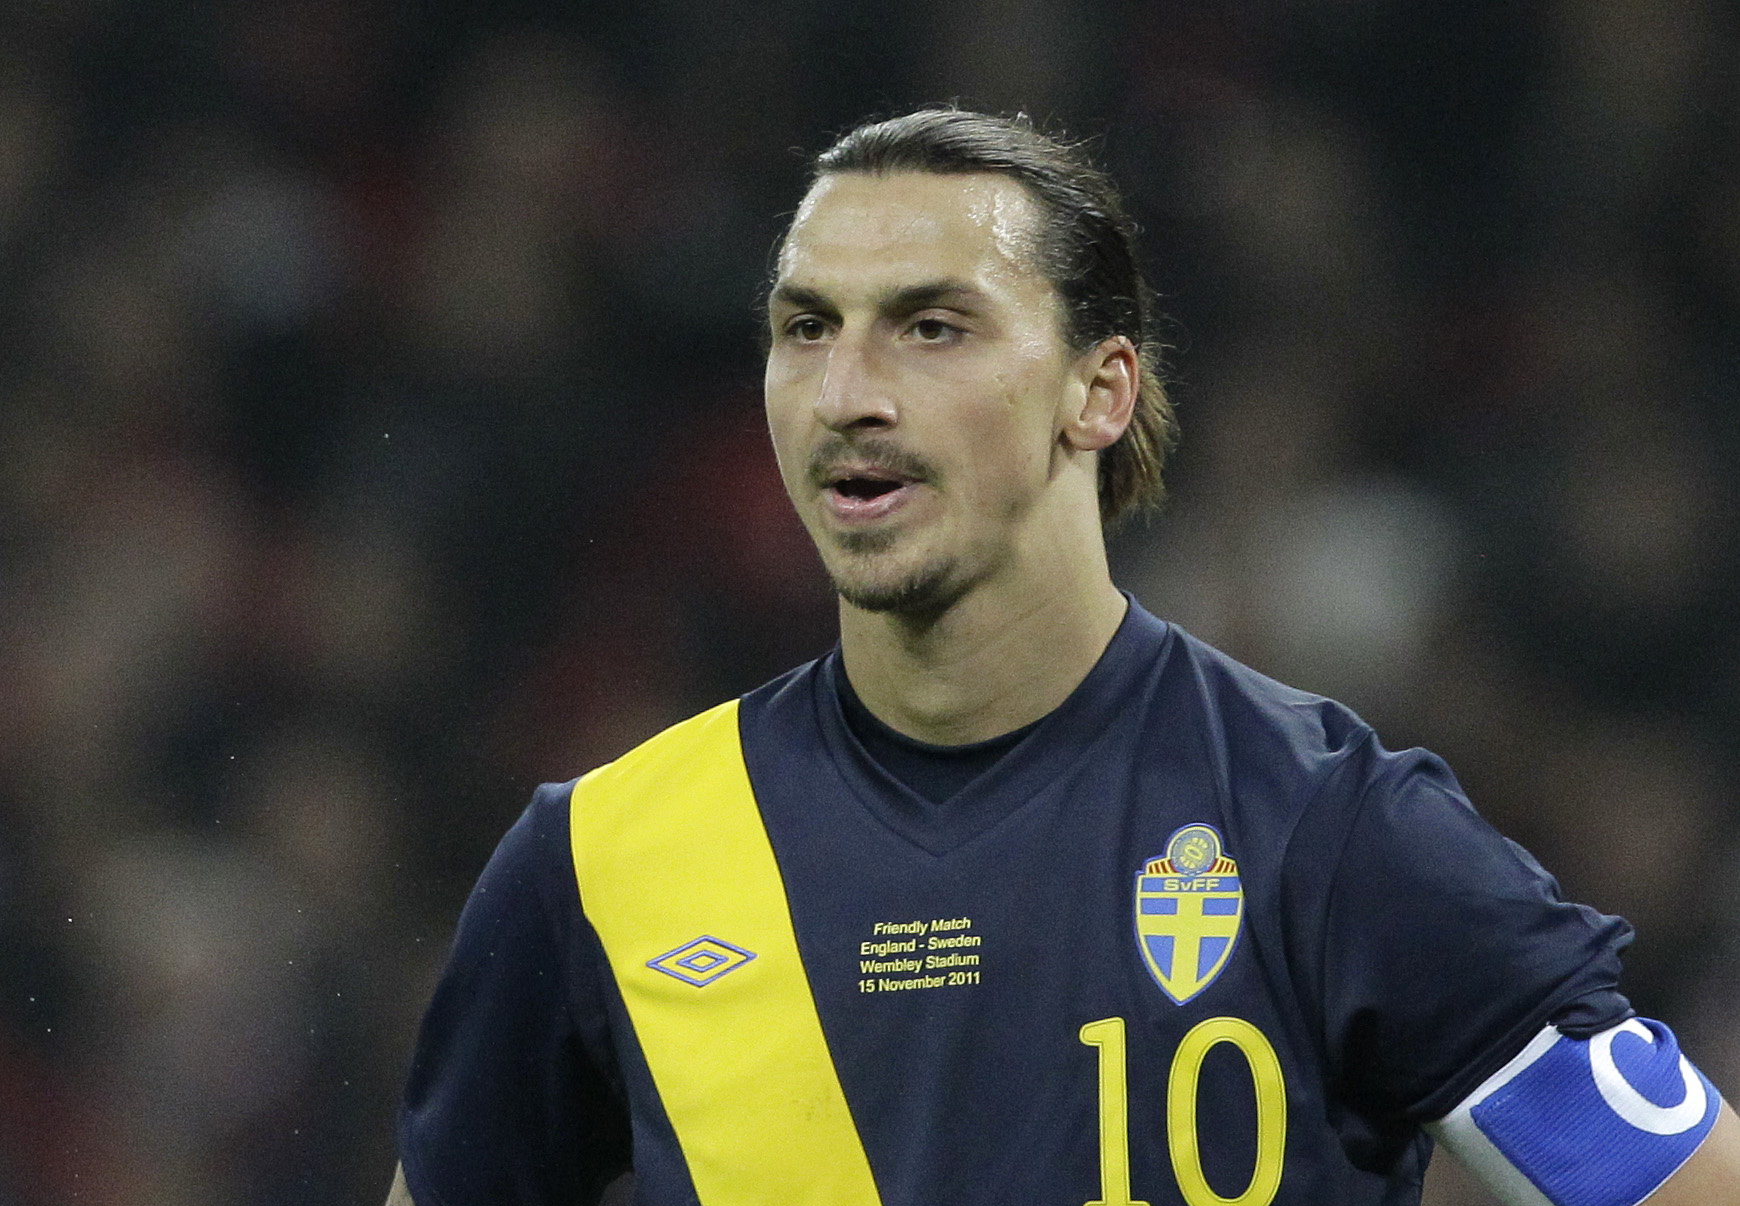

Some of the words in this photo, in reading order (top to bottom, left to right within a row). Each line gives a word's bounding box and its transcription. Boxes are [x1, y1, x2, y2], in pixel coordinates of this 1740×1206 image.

[1163, 878, 1220, 891] SvFF
[873, 920, 928, 936] Friendly
[930, 916, 971, 932] Match
[860, 938, 916, 957] England
[927, 934, 981, 950] Sweden
[859, 958, 923, 974] Wembley
[925, 953, 980, 970] Stadium
[858, 979, 876, 993] 15
[878, 974, 946, 992] November
[947, 971, 980, 986] 2011
[1589, 1018, 1707, 1136] C
